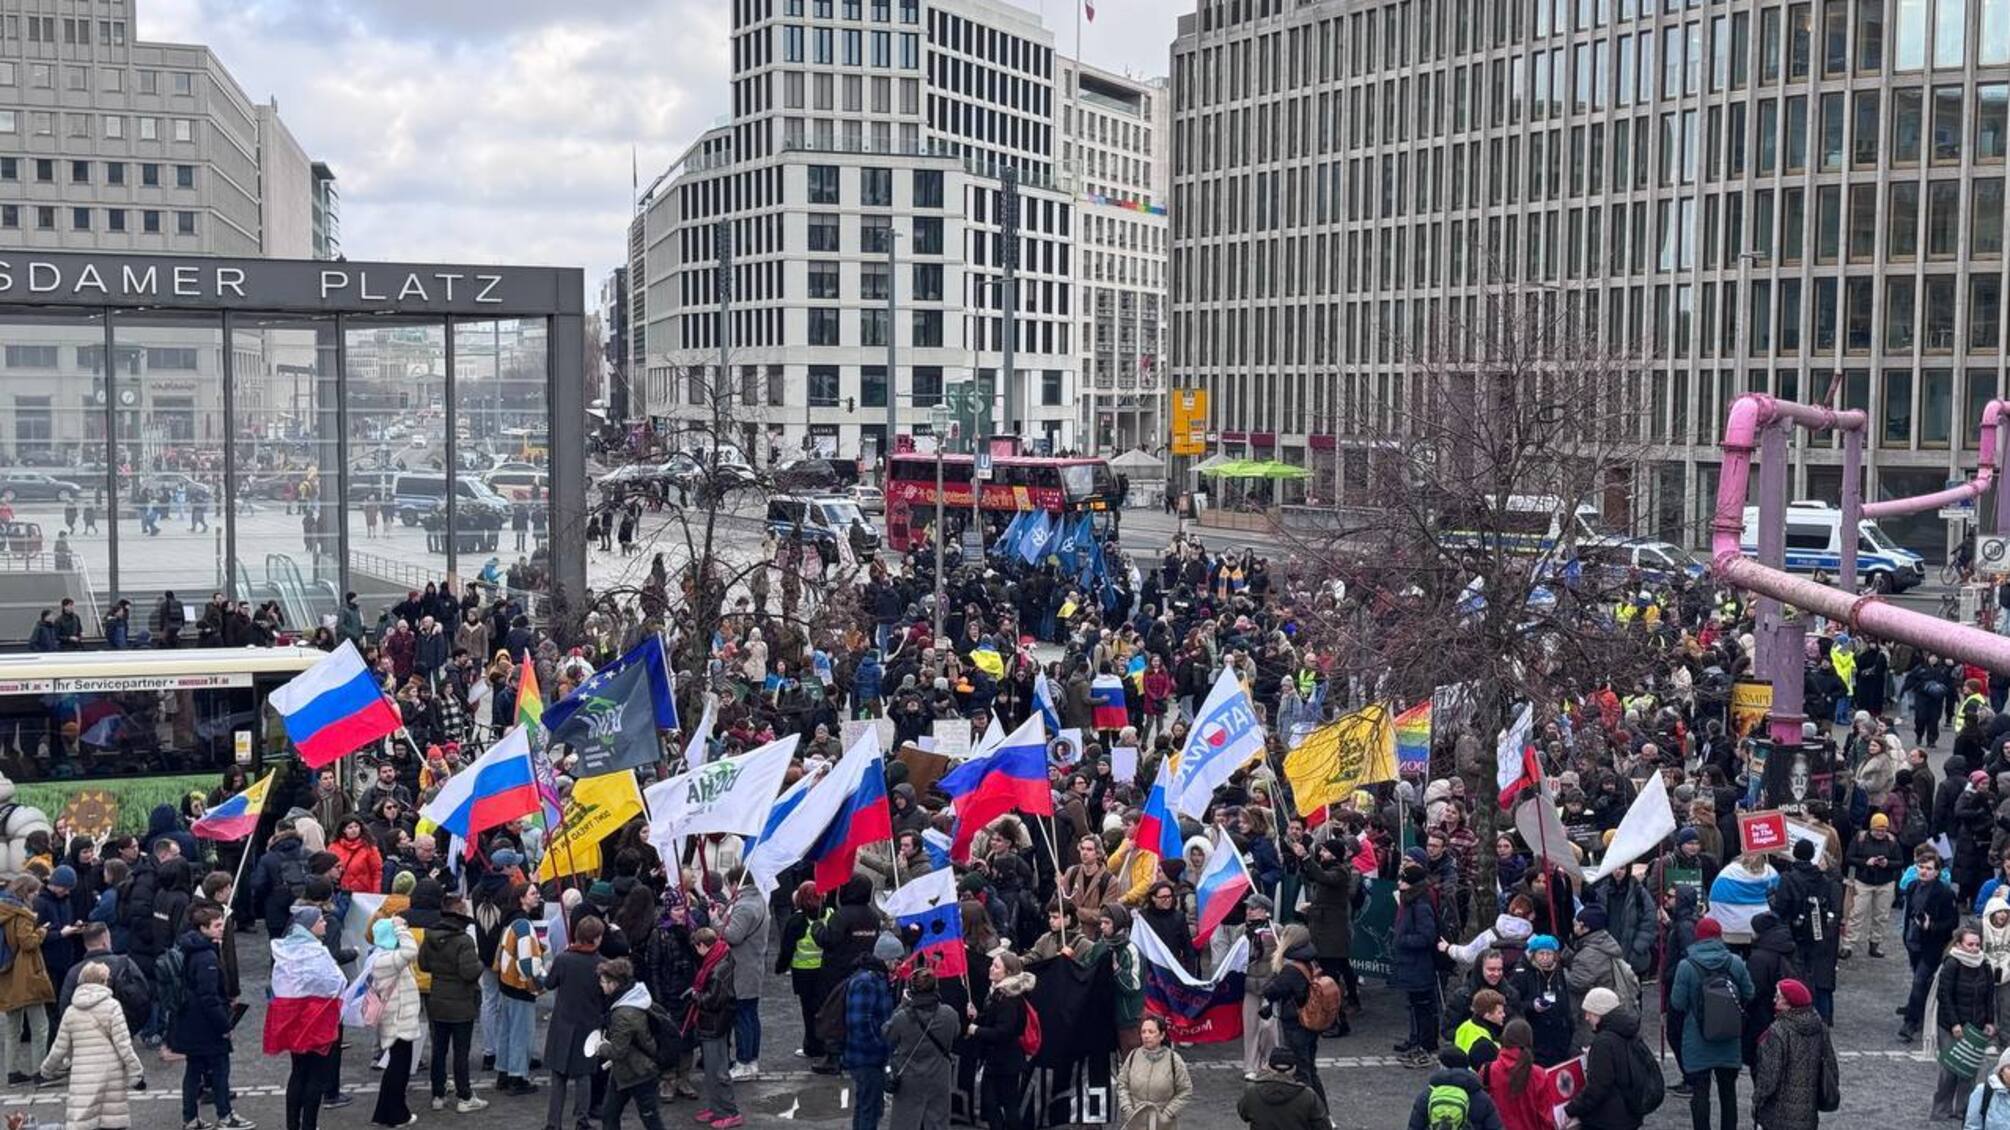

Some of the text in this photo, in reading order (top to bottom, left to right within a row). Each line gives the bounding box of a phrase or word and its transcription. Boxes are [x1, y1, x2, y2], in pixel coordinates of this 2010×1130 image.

[321, 271, 503, 303] PLATZ
[981, 454, 989, 468] U
[1986, 545, 2001, 557] 30
[54, 679, 71, 691] Ihr
[75, 678, 168, 692] Servicepartner
